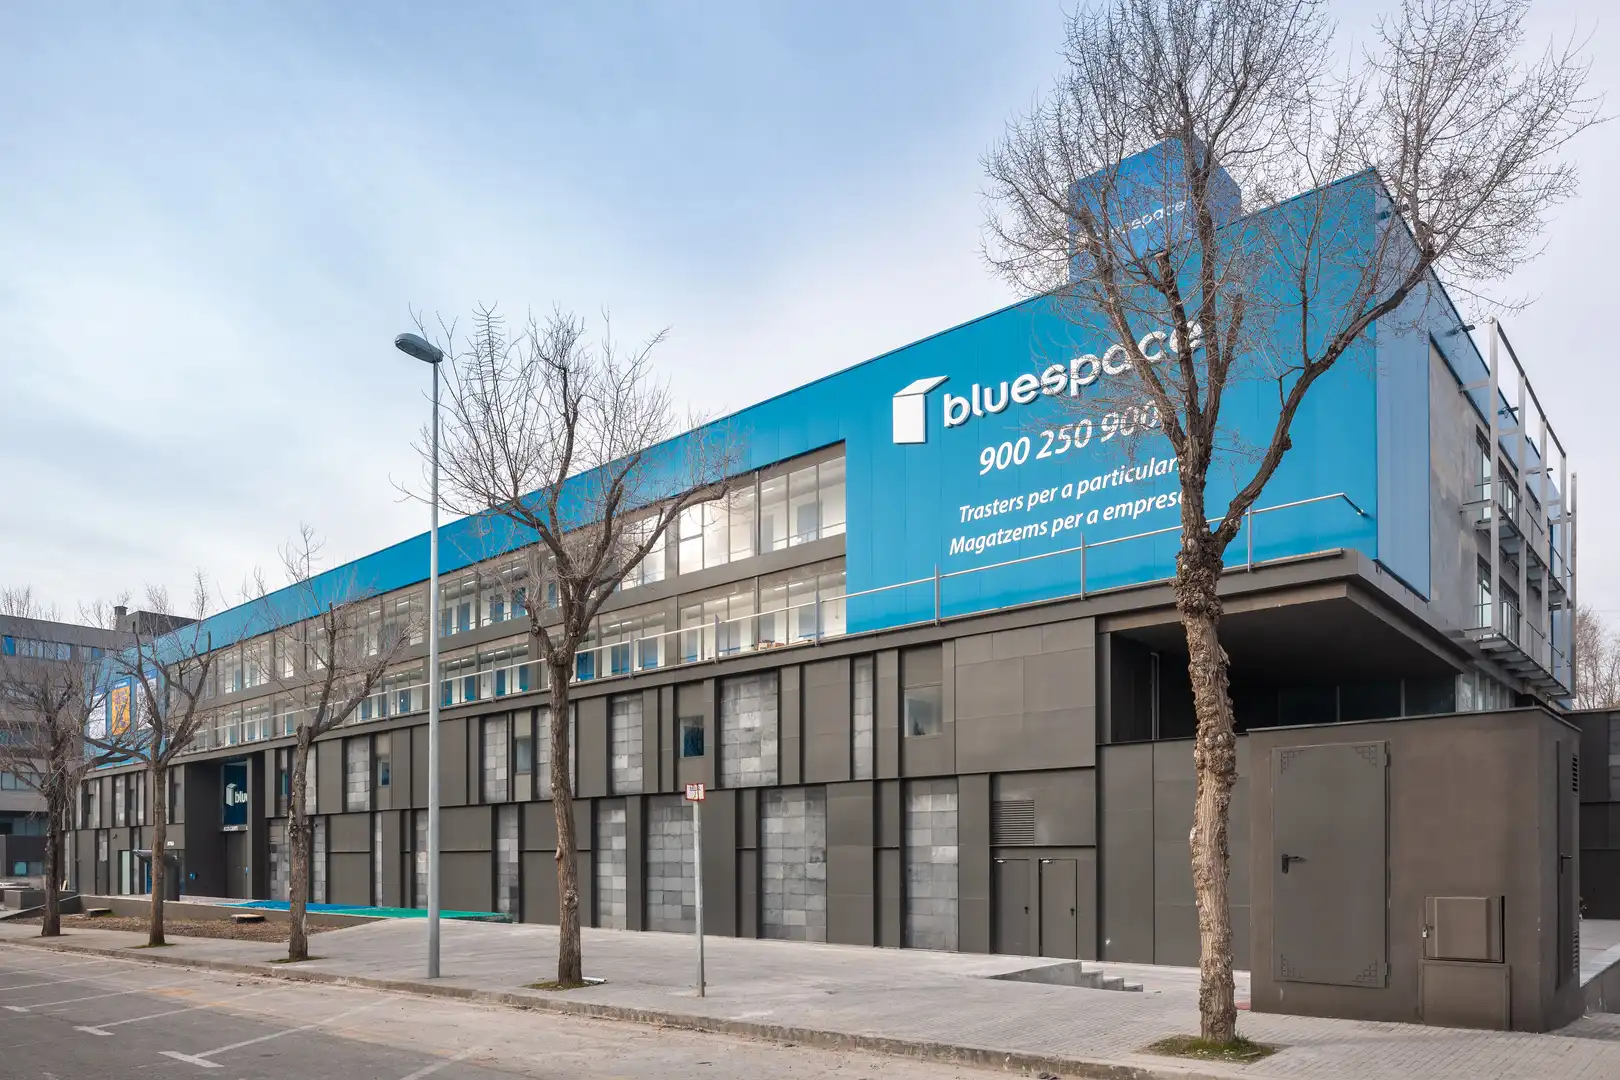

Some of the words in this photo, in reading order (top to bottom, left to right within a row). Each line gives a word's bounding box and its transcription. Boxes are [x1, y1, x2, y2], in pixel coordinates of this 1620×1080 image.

[943, 321, 1203, 427] bluespace
[980, 436, 1031, 476] 900
[1036, 418, 1092, 460] 250
[1100, 400, 1161, 443] 900
[960, 495, 1024, 523] Trasters
[1027, 486, 1058, 512] per
[1061, 483, 1073, 499] a
[1076, 457, 1180, 500] particular
[949, 520, 1048, 556] Magatzems
[1051, 512, 1083, 538] per
[1086, 509, 1099, 525] a
